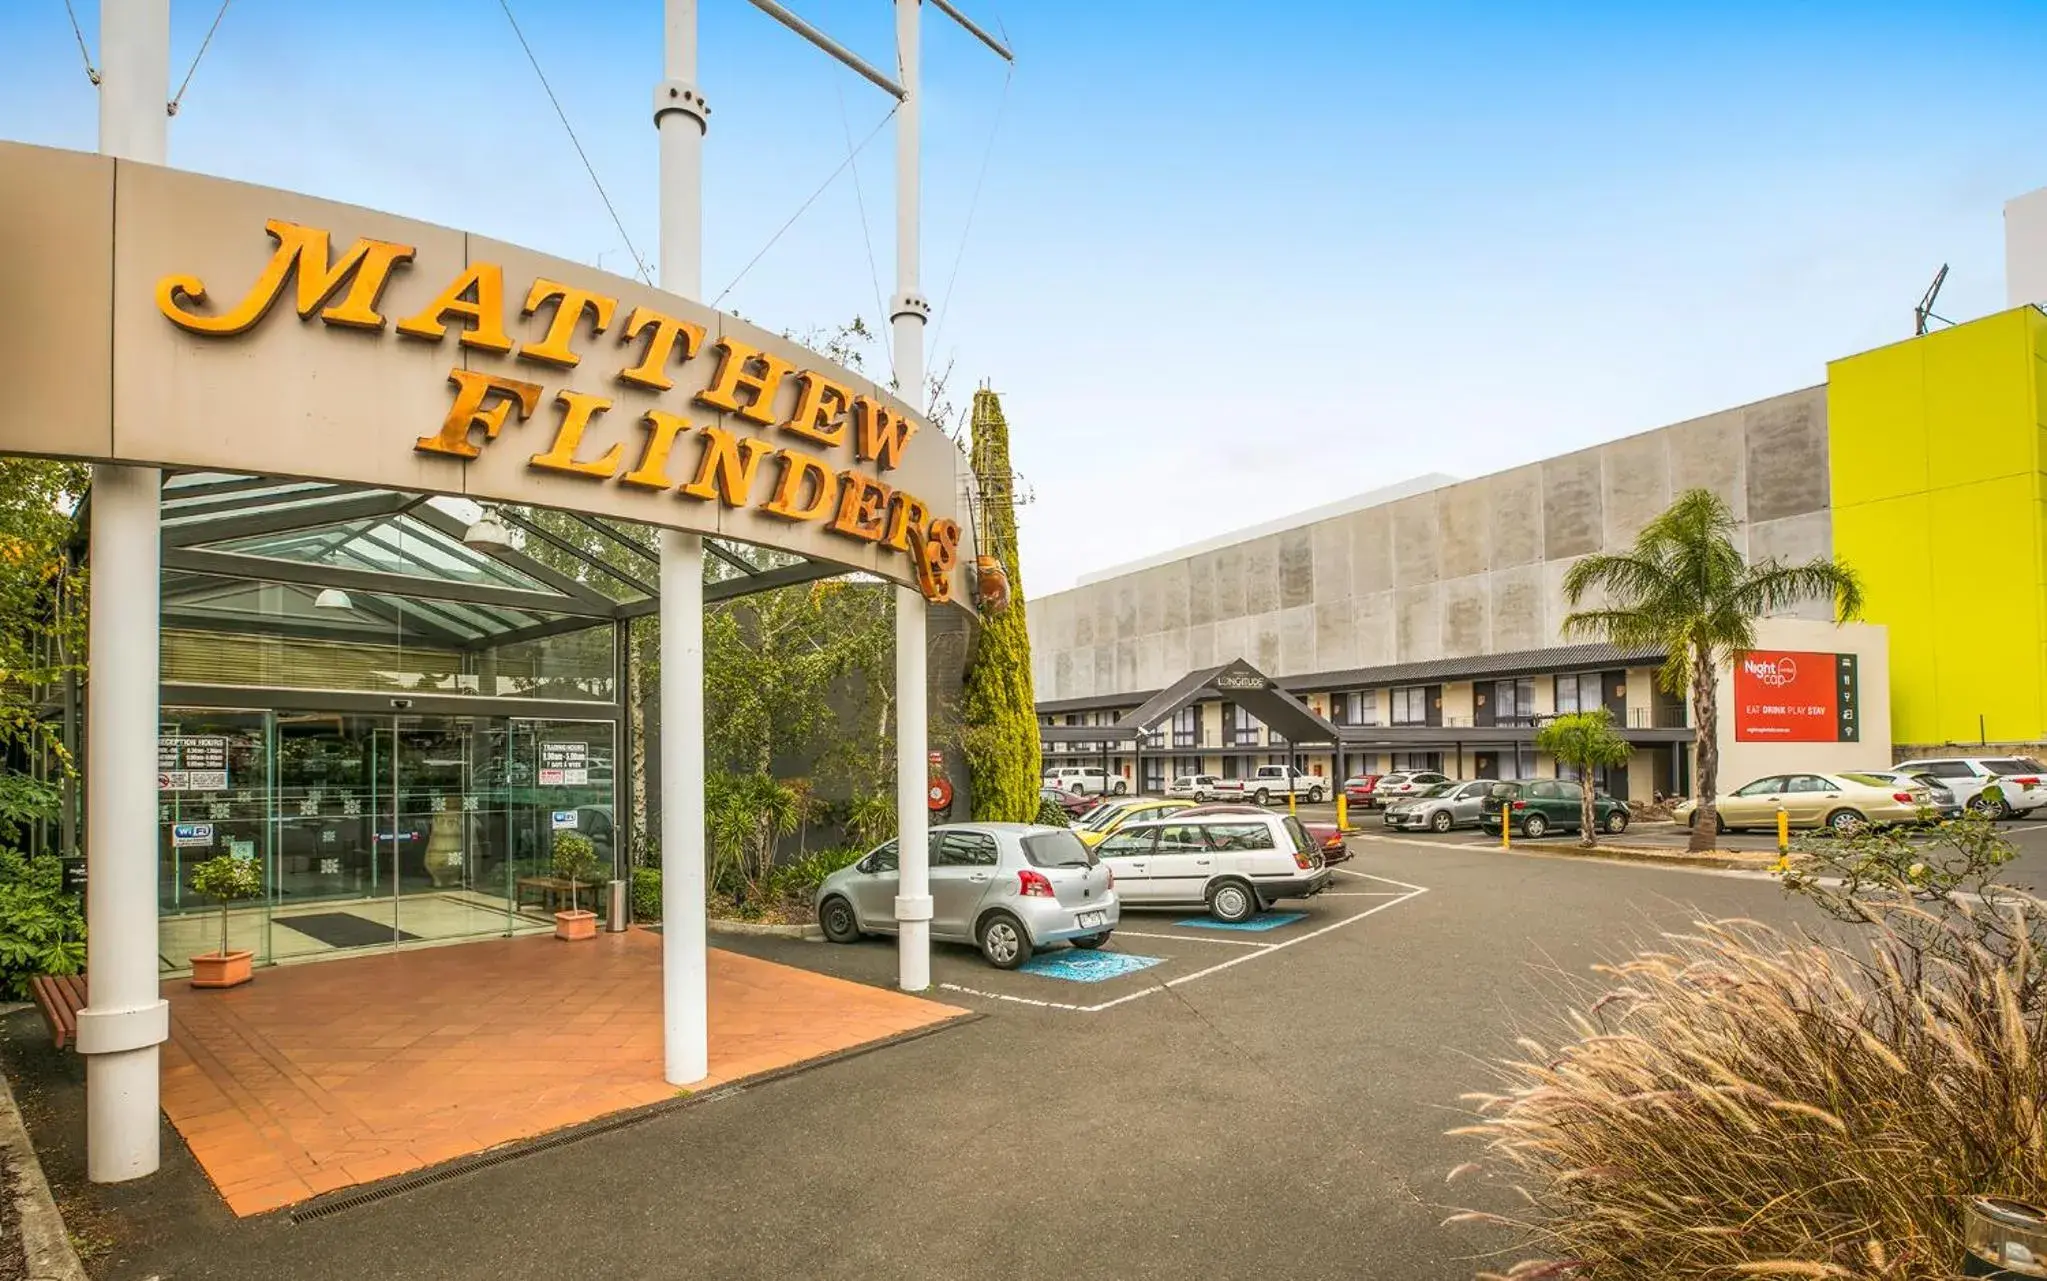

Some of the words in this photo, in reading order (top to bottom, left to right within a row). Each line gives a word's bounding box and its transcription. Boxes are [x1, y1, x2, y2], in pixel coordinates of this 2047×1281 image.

[156, 217, 920, 471] MATTHEW
[414, 367, 962, 603] FLINDERS
[1744, 660, 1776, 679] Night
[1764, 674, 1786, 687] cap
[1746, 705, 1760, 714] EAT
[1763, 705, 1786, 715] DRINK
[1787, 706, 1806, 715] PLAY
[1807, 706, 1826, 716] STAY
